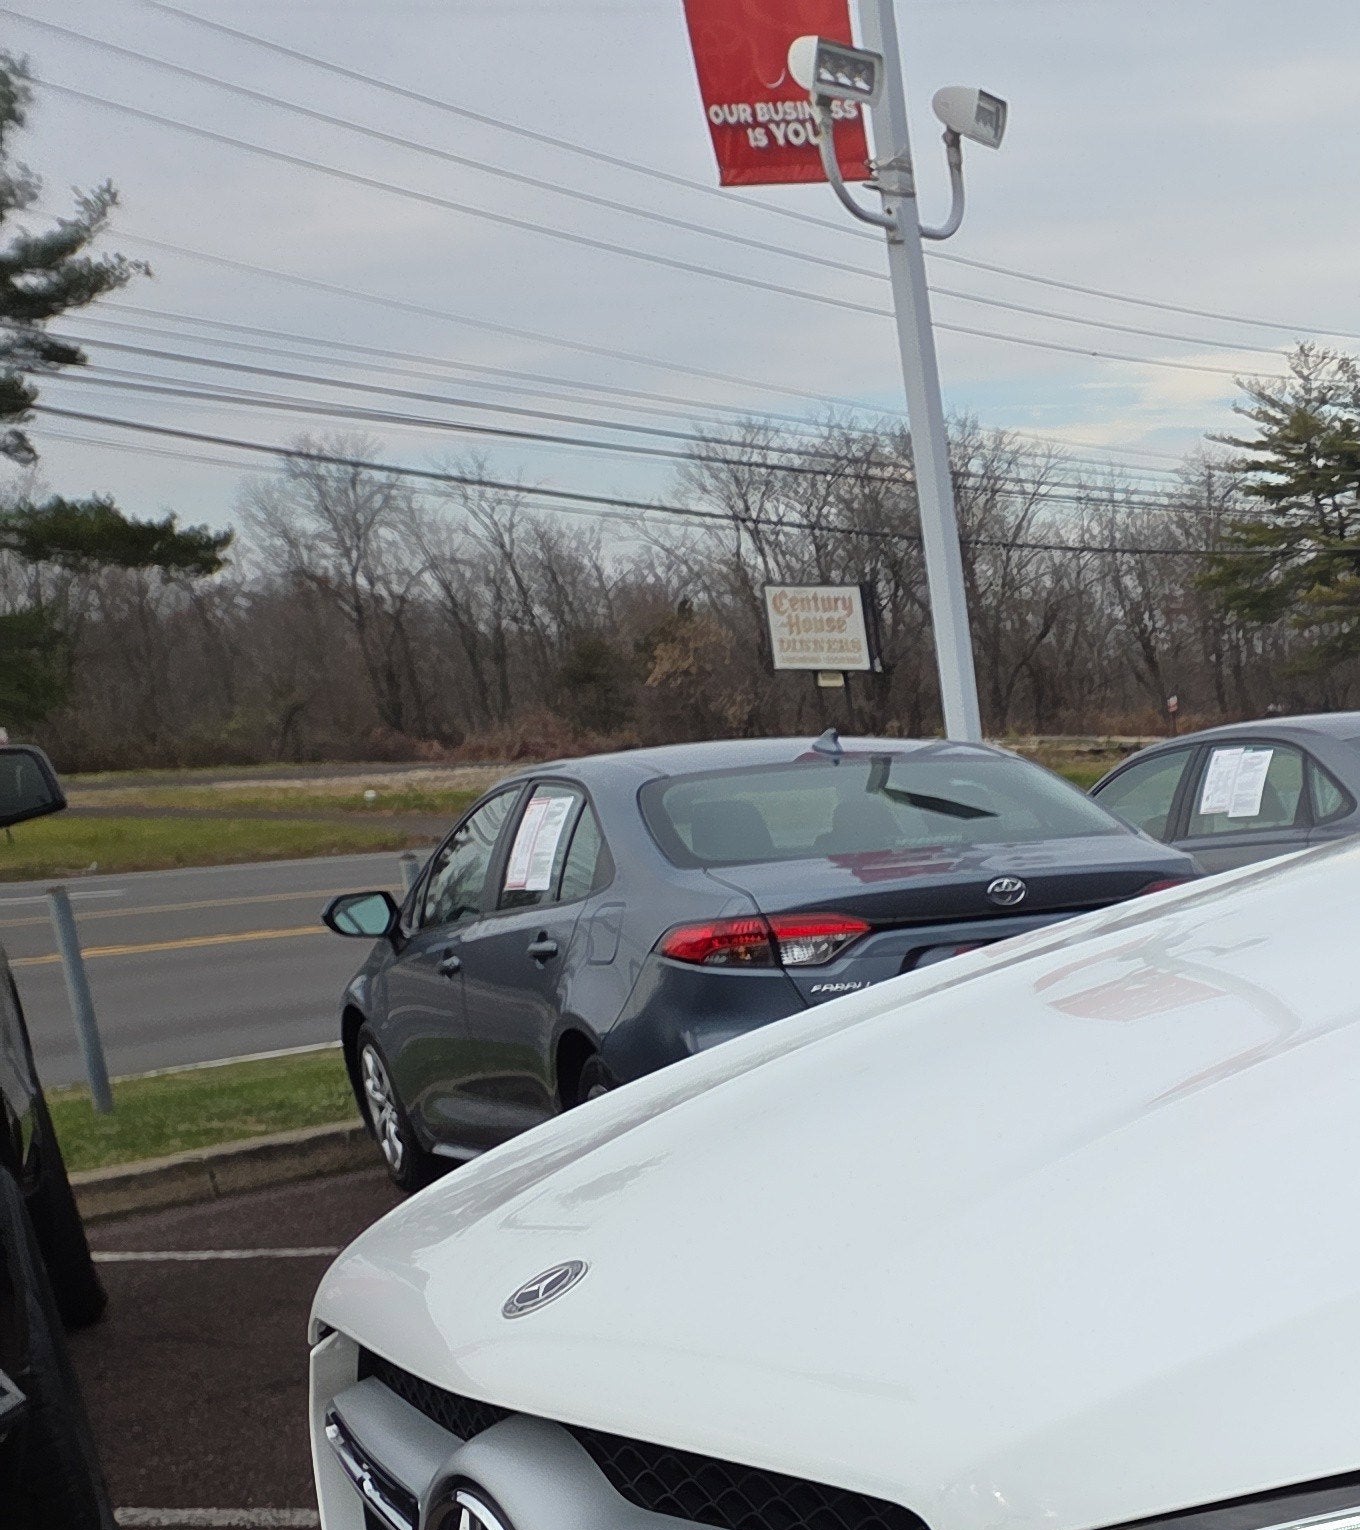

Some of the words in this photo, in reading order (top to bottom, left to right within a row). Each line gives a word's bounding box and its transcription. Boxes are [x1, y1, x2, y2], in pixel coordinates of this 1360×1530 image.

[708, 103, 753, 125] OUR
[754, 100, 859, 123] BUSINSS
[746, 126, 768, 148] IS
